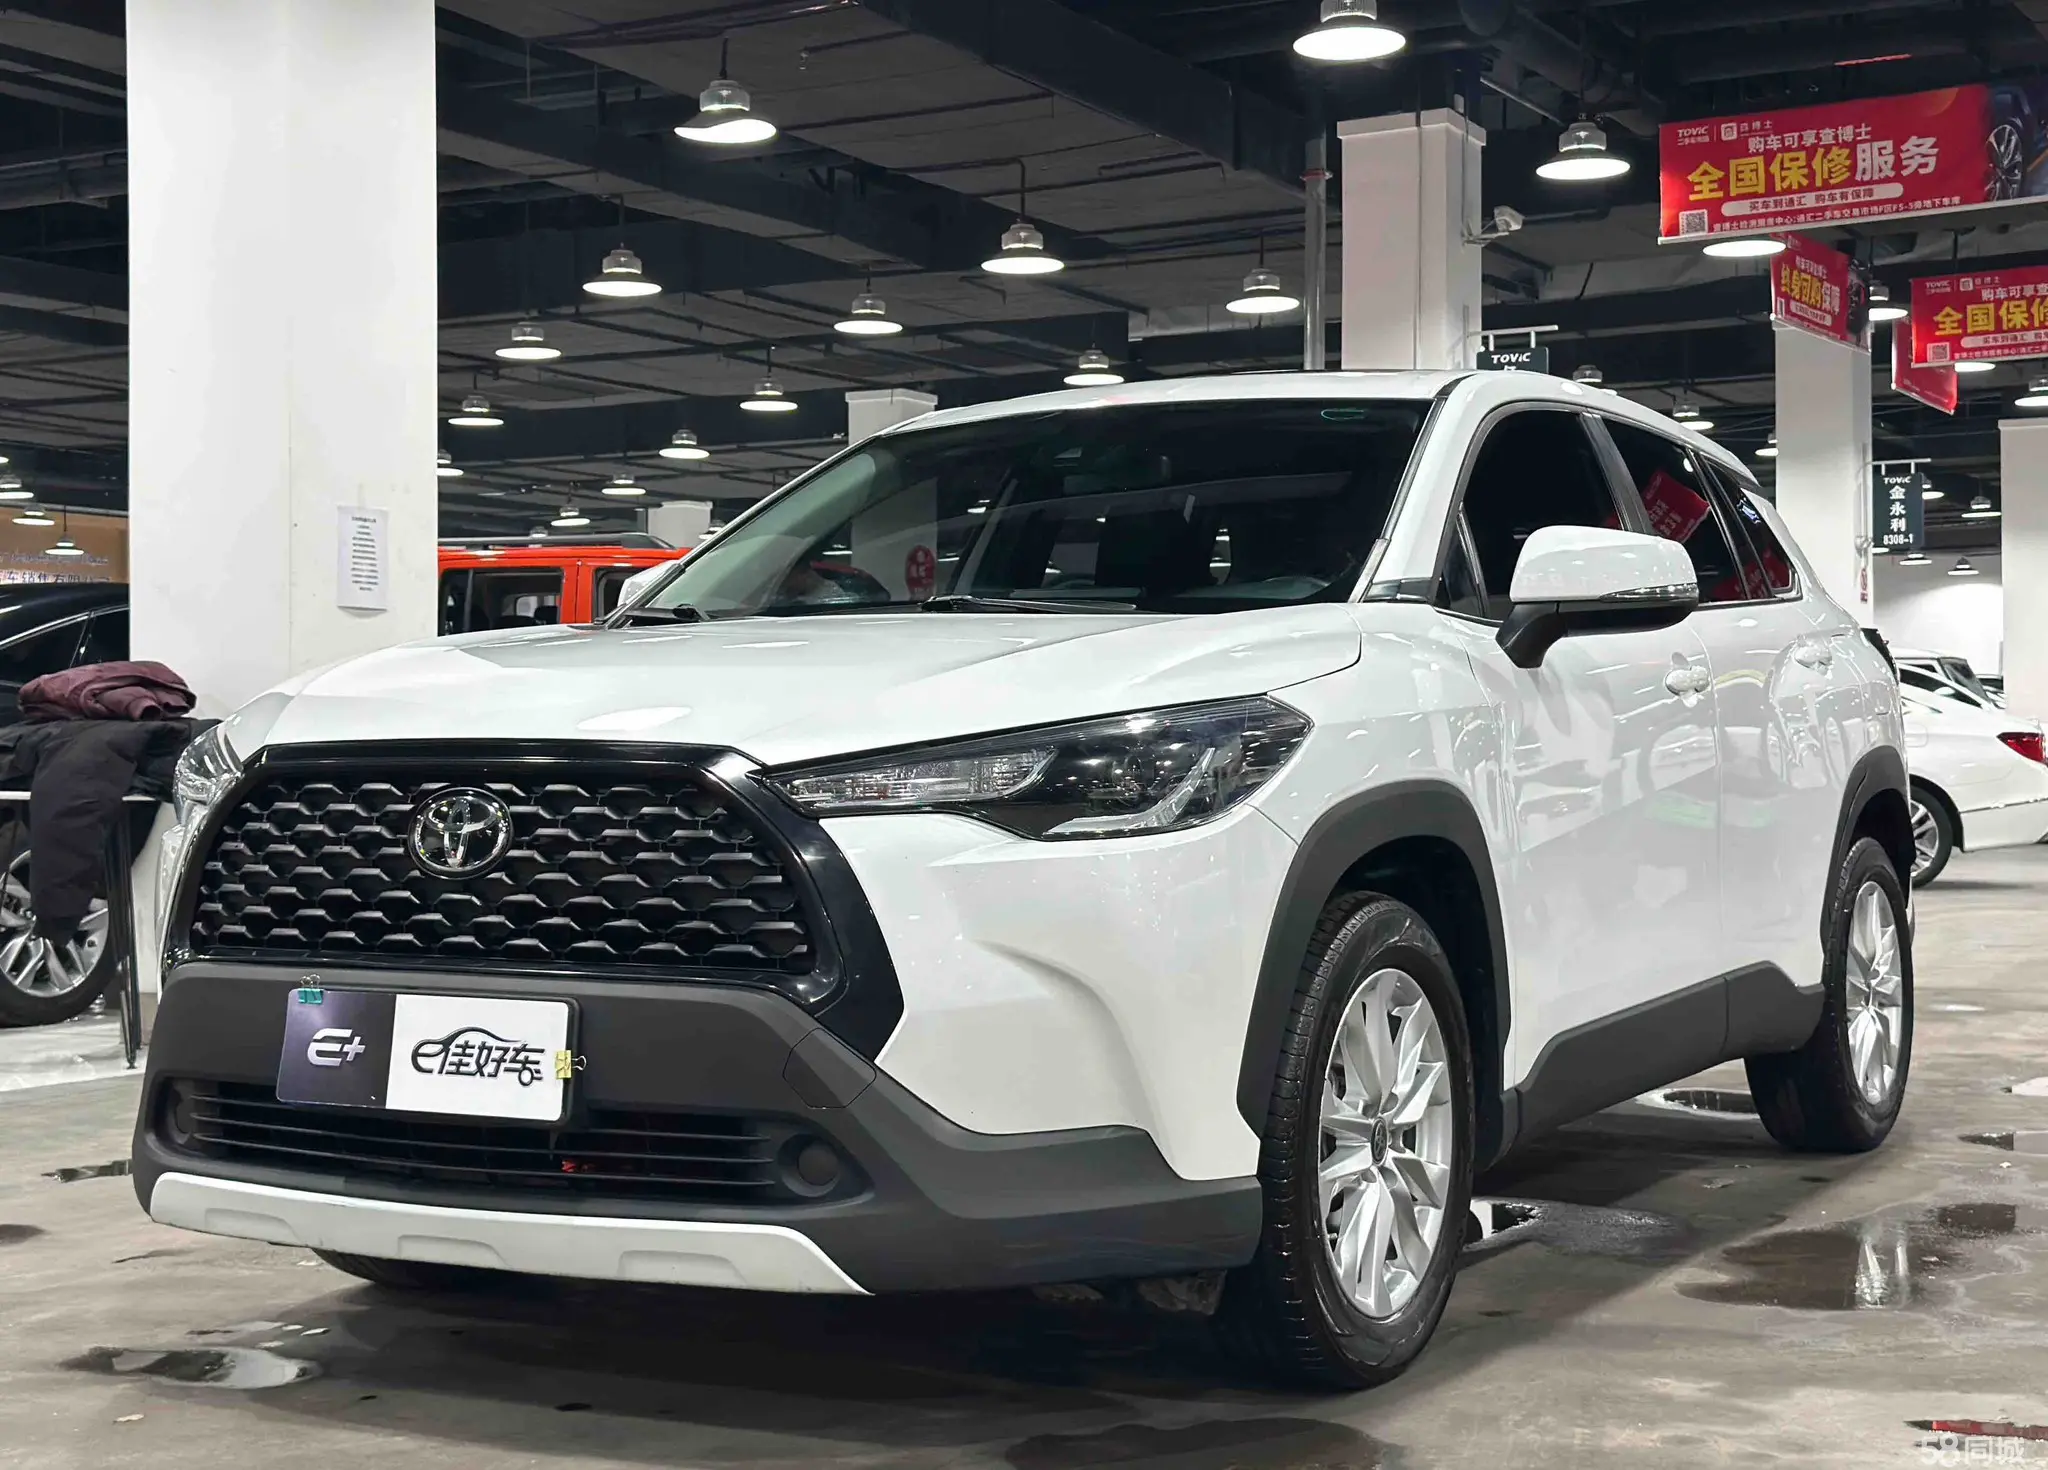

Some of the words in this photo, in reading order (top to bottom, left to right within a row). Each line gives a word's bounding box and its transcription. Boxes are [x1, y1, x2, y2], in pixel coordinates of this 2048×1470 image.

[1748, 123, 1872, 154] 购车可享查博士
[1687, 136, 1940, 201] 全国保修服务
[1491, 352, 1532, 364] TOVIC
[1883, 475, 1912, 485] TOVIC
[1889, 484, 1906, 533] 金永利
